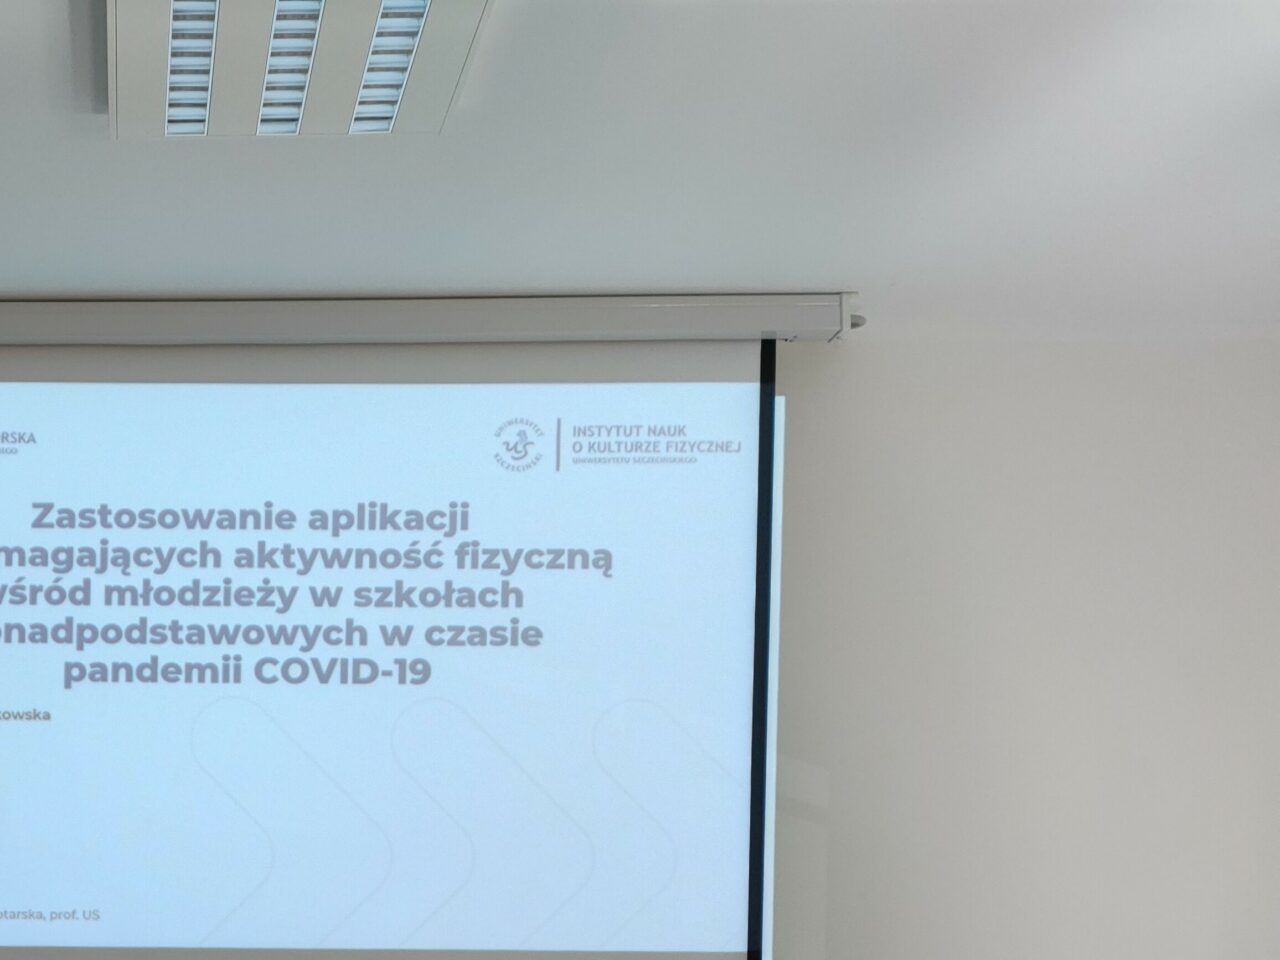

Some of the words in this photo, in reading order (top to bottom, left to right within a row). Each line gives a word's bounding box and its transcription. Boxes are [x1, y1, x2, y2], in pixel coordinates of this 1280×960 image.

[571, 440, 584, 454] O
[587, 440, 661, 454] KULTURZE
[665, 440, 742, 454] FIZYCZNEJ
[572, 424, 644, 438] INSTYTUT
[647, 424, 687, 438] NAUK
[30, 501, 297, 531] Zastosowanie
[308, 501, 470, 537] aplikacji
[233, 540, 444, 576] aktywność
[454, 540, 613, 577] fizyczną
[104, 577, 300, 615] młodzieży
[308, 586, 344, 608] w
[353, 580, 524, 609] szkołach
[378, 625, 414, 647] w
[424, 616, 544, 648] czasie
[63, 654, 243, 690] pandemii
[253, 656, 432, 685] COVID-19
[49, 908, 80, 922] prof.
[82, 908, 101, 921] US
